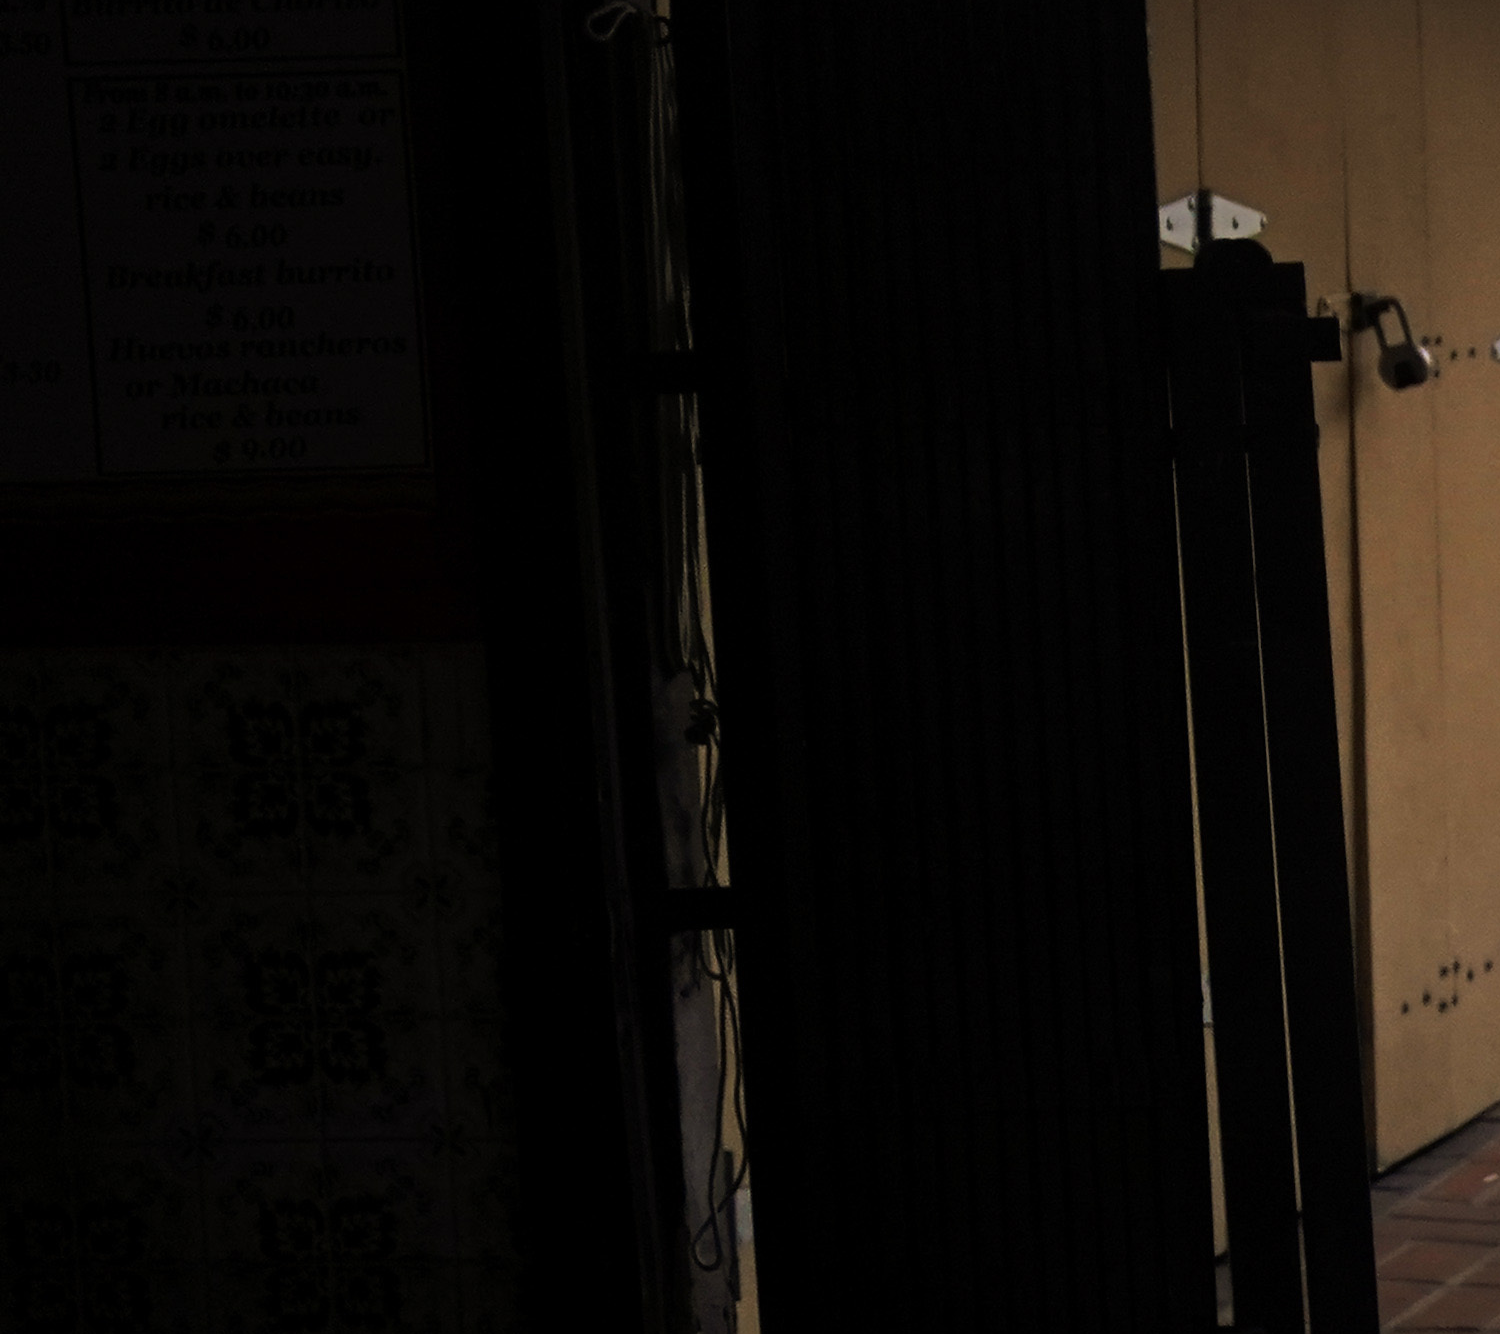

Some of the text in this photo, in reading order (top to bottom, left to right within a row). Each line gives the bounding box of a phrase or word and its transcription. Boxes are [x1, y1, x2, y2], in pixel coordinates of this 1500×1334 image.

[208, 27, 270, 52] 6.00
[83, 79, 148, 105] From
[126, 106, 190, 138] Egg
[200, 106, 340, 132] omelette
[358, 105, 397, 127] or
[128, 145, 206, 177] Eggs
[216, 147, 288, 170] over
[145, 183, 346, 212] rice & beans
[225, 223, 289, 250] 6.00
[106, 258, 396, 293] Breakfast burrito
[232, 305, 296, 332] 6.00
[107, 331, 408, 363] Huevos rancheros
[125, 369, 320, 399] or Machaca
[161, 402, 362, 430] rice & beans
